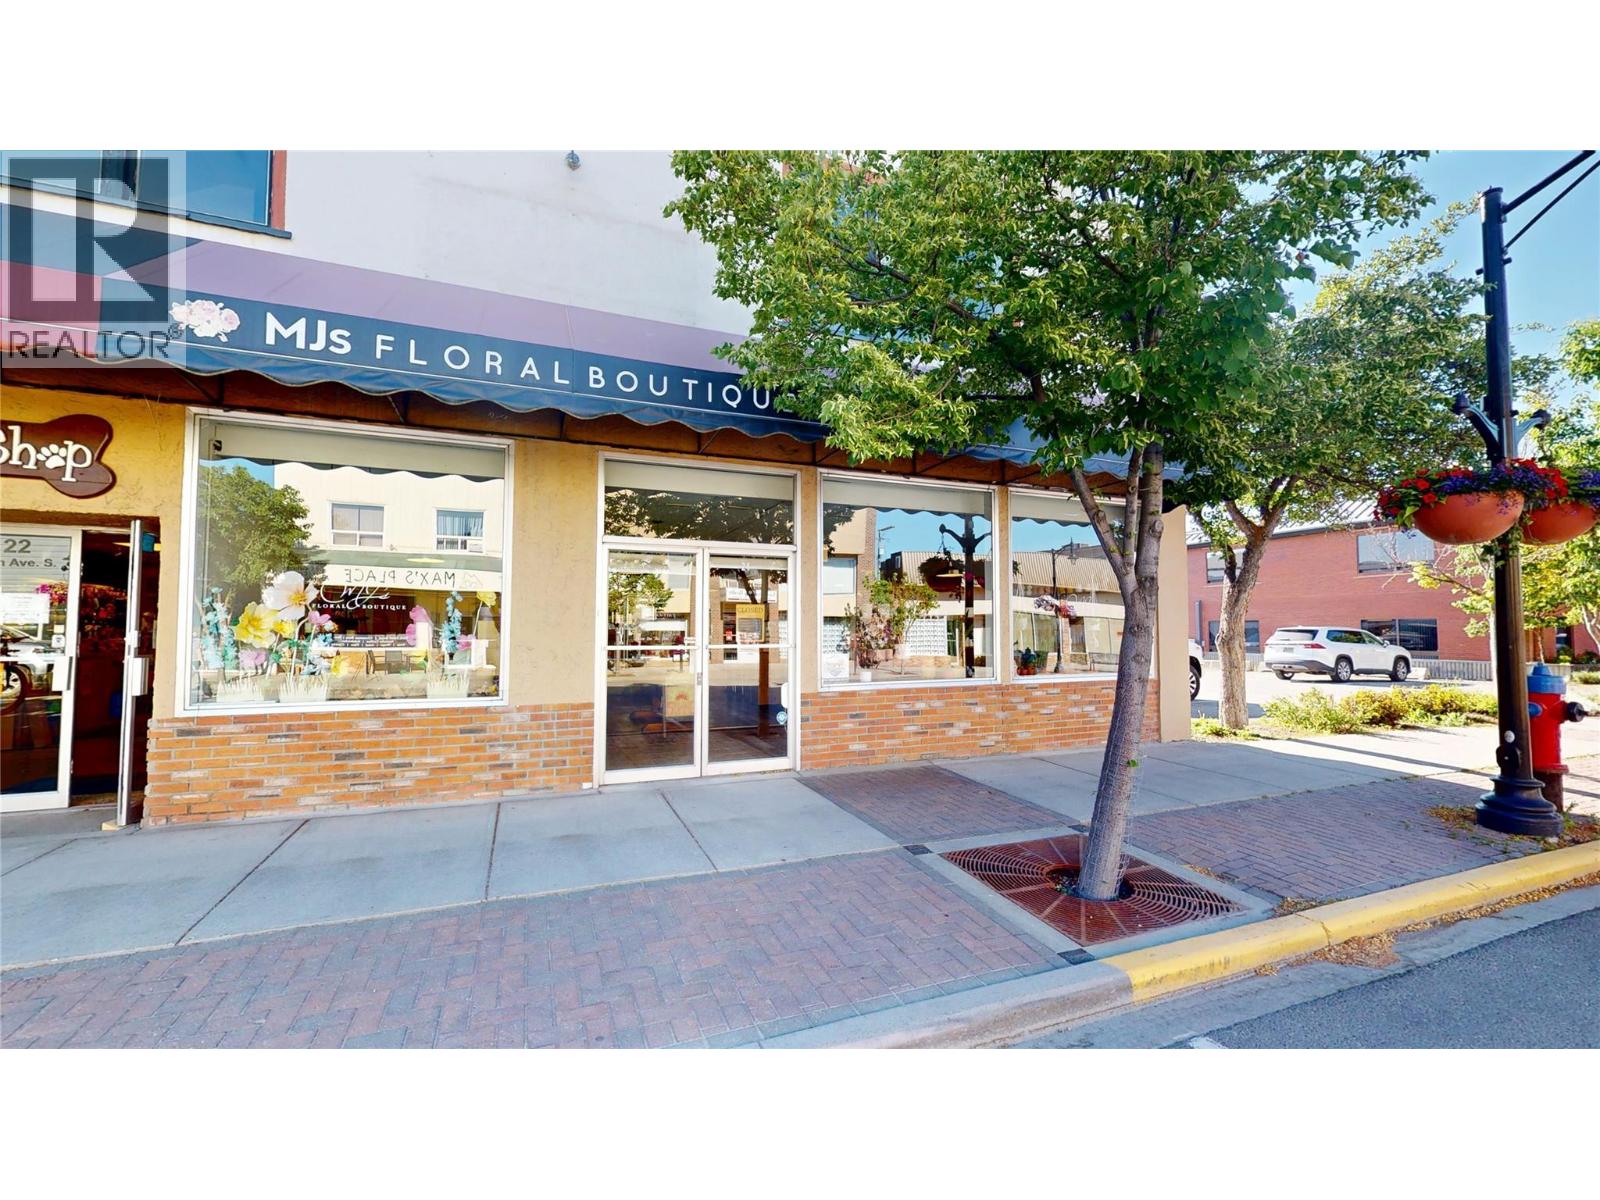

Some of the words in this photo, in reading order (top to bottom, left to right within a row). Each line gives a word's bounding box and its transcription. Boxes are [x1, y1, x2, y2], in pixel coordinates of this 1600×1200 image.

[265, 311, 352, 355] MJs
[375, 333, 570, 385] FLORAL
[3, 538, 32, 554] 22
[9, 558, 40, 568] Ave.
[44, 558, 57, 568] S.
